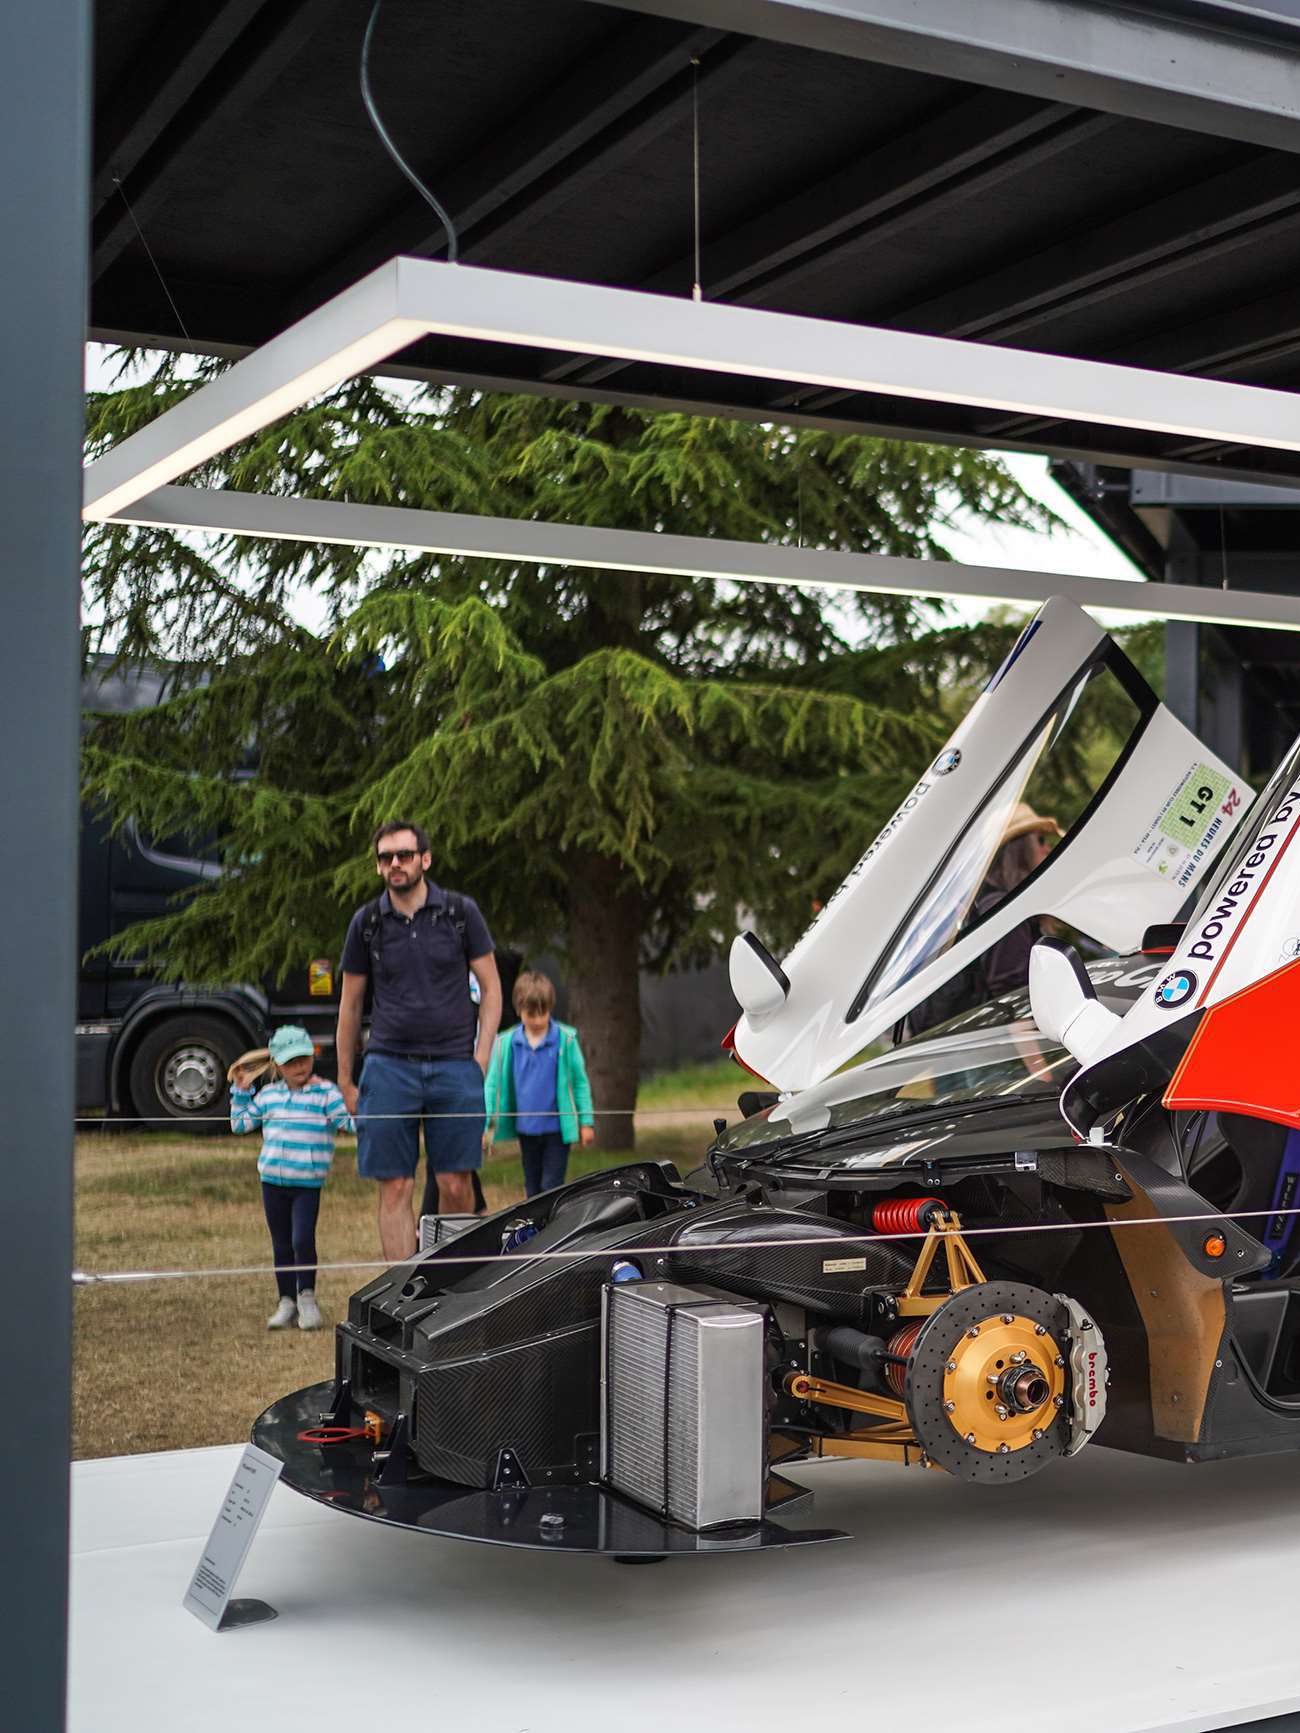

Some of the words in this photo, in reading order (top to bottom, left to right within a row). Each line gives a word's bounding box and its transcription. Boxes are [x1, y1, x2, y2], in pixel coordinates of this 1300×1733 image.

[1190, 786, 1213, 814] GT
[1221, 787, 1241, 816] 24
[852, 783, 930, 876] powered
[1200, 817, 1223, 849] HEURES
[1192, 849, 1204, 863] DU
[1178, 863, 1196, 888] MANS
[1187, 832, 1278, 961] powered
[1088, 1352, 1098, 1407] brembo
